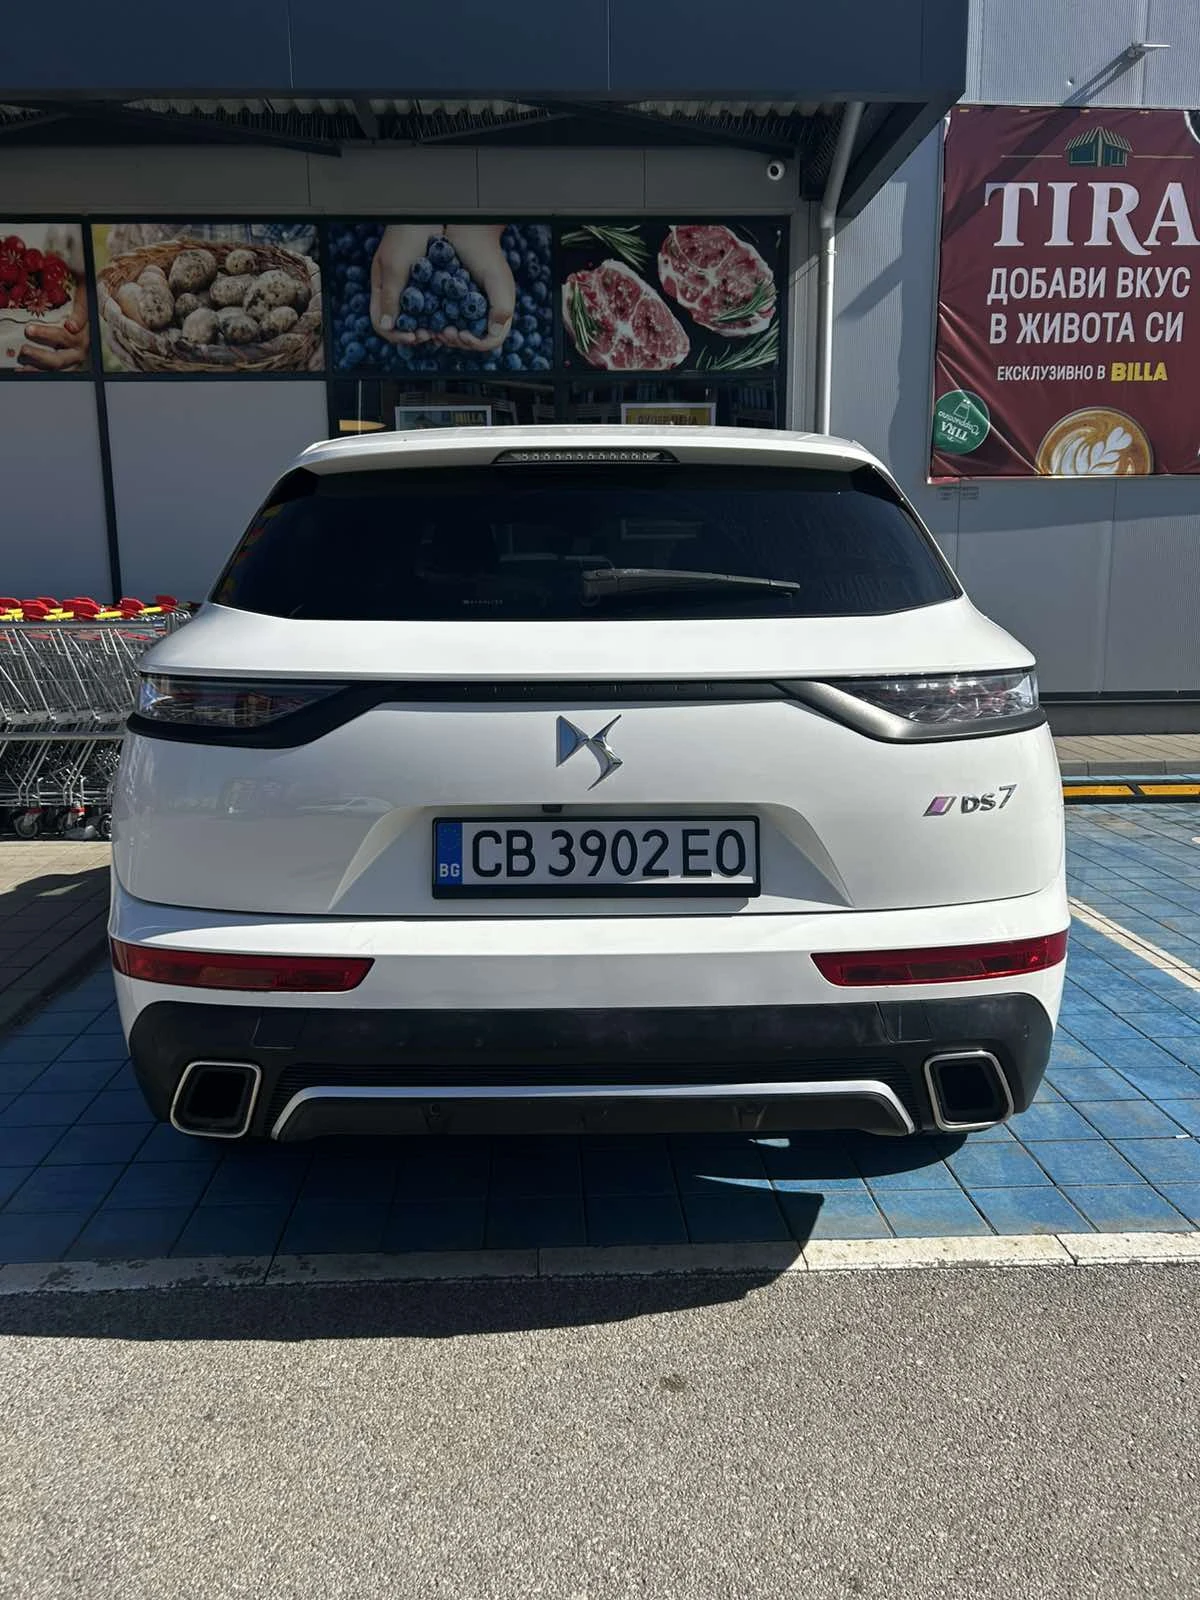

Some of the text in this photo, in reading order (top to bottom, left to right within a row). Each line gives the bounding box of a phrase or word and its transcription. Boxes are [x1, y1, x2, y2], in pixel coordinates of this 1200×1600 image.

[985, 182, 1200, 256] TIRA
[987, 266, 1191, 305] ДОБАВИ ВКУС
[989, 311, 1184, 344] В ЖИВОТА СИ
[997, 362, 1168, 382] ЕКСКЛУЗИВНО В BILLA
[942, 421, 968, 441] TIRA
[439, 863, 460, 877] BG
[548, 829, 670, 877] 3902
